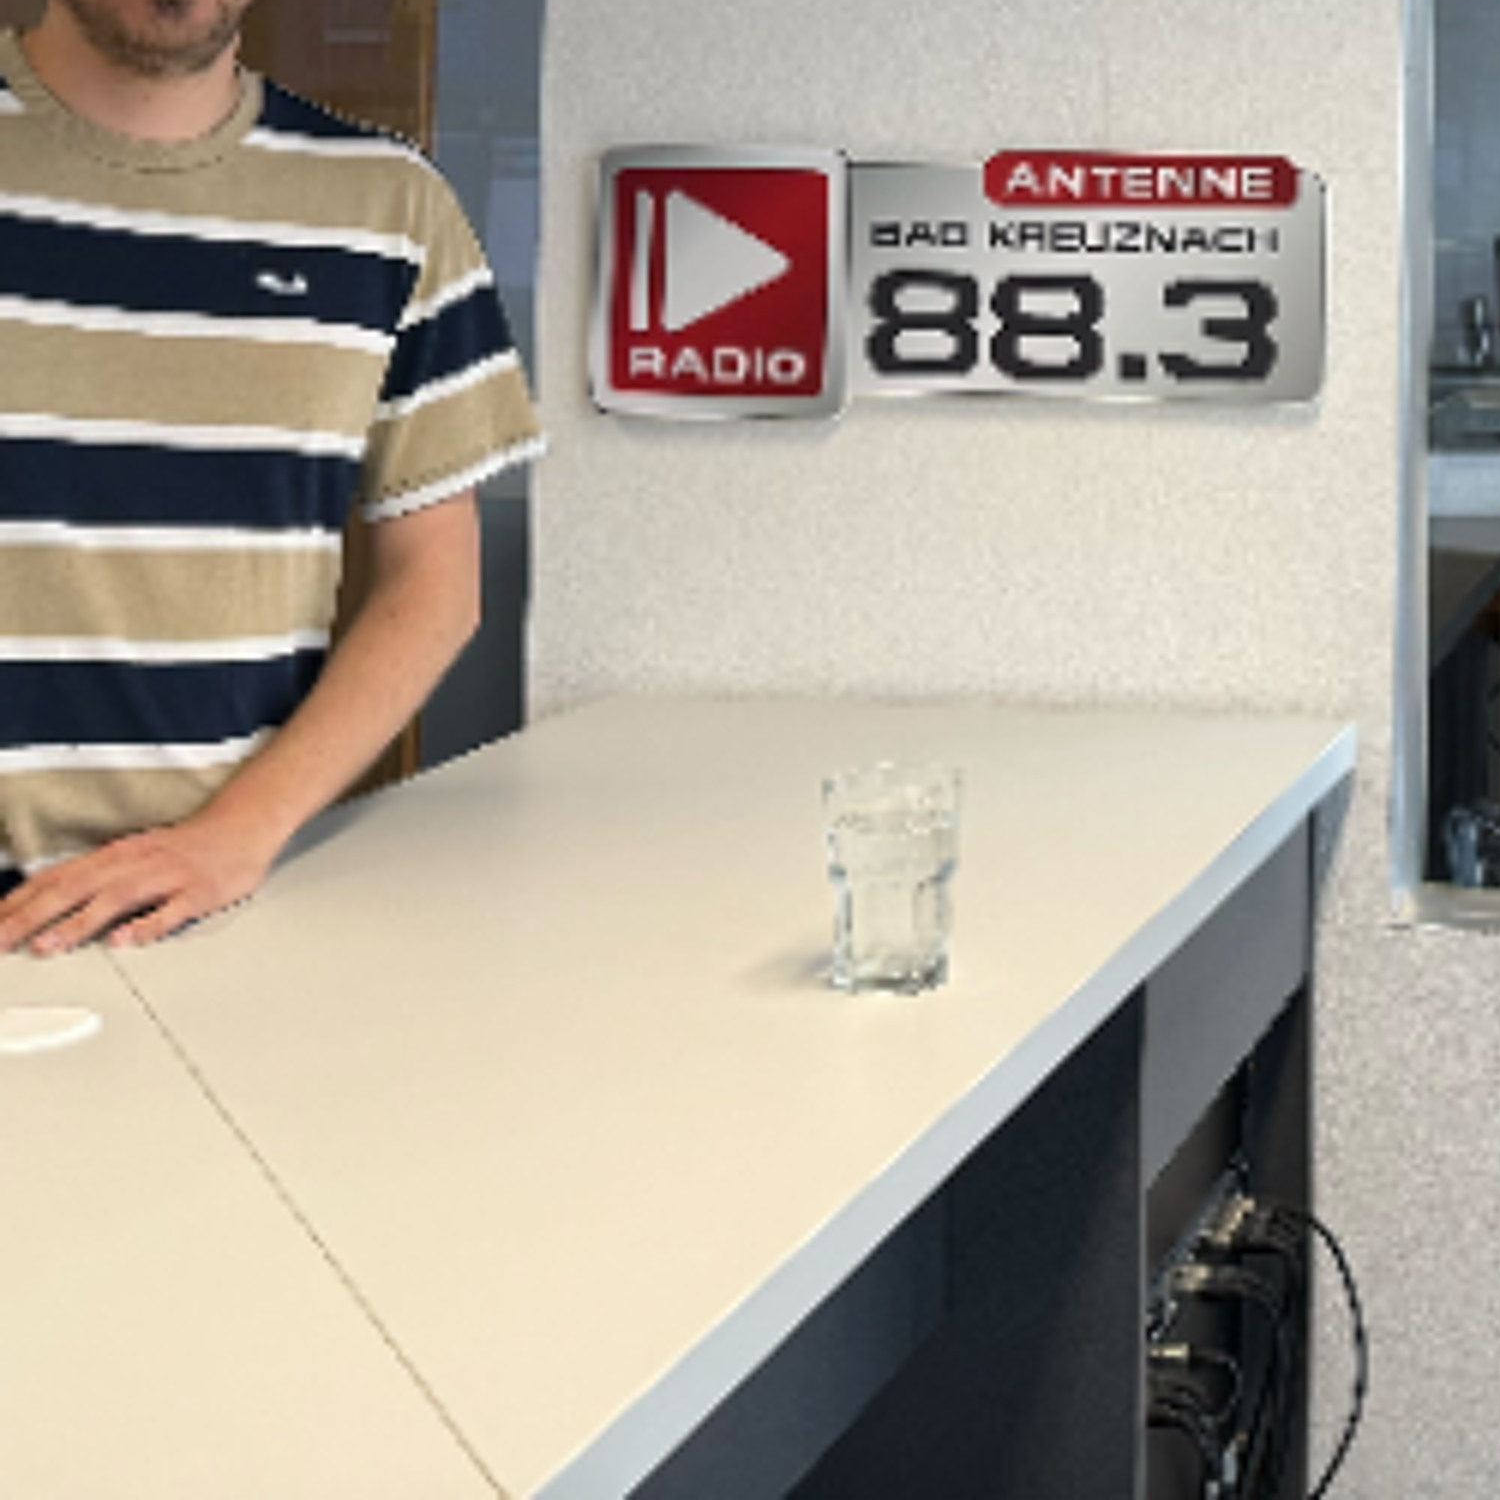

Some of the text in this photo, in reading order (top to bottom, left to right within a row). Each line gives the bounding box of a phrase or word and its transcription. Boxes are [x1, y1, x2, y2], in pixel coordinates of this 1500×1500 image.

[1004, 161, 1275, 199] ANTENNE
[871, 222, 1280, 253] BAD KREUZNACH
[865, 269, 1280, 383] 88.3
[626, 347, 806, 383] RADIO
